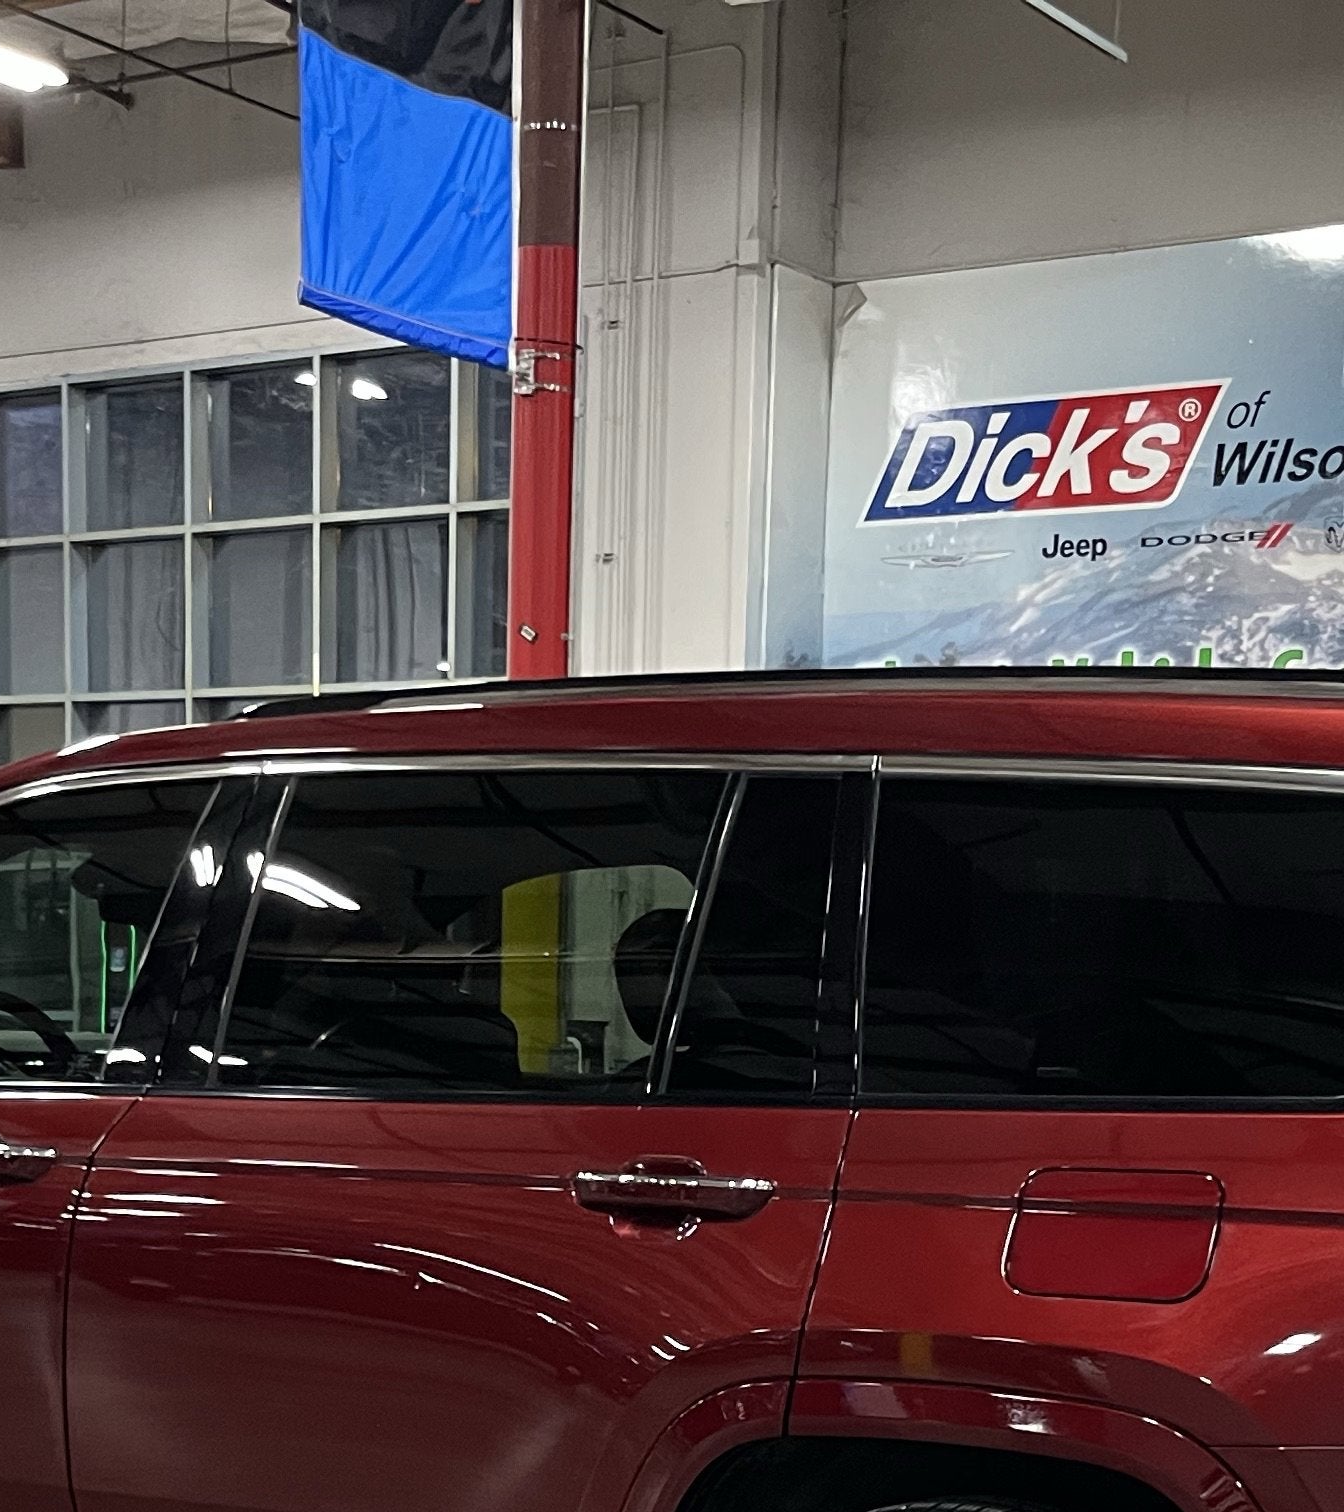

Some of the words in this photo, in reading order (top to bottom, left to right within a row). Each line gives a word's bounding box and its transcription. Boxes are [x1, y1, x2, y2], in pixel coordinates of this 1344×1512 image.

[885, 400, 1181, 508] Dick's
[1226, 390, 1271, 429] of
[1042, 534, 1107, 561] Jeep
[1140, 531, 1273, 548] DODGE
